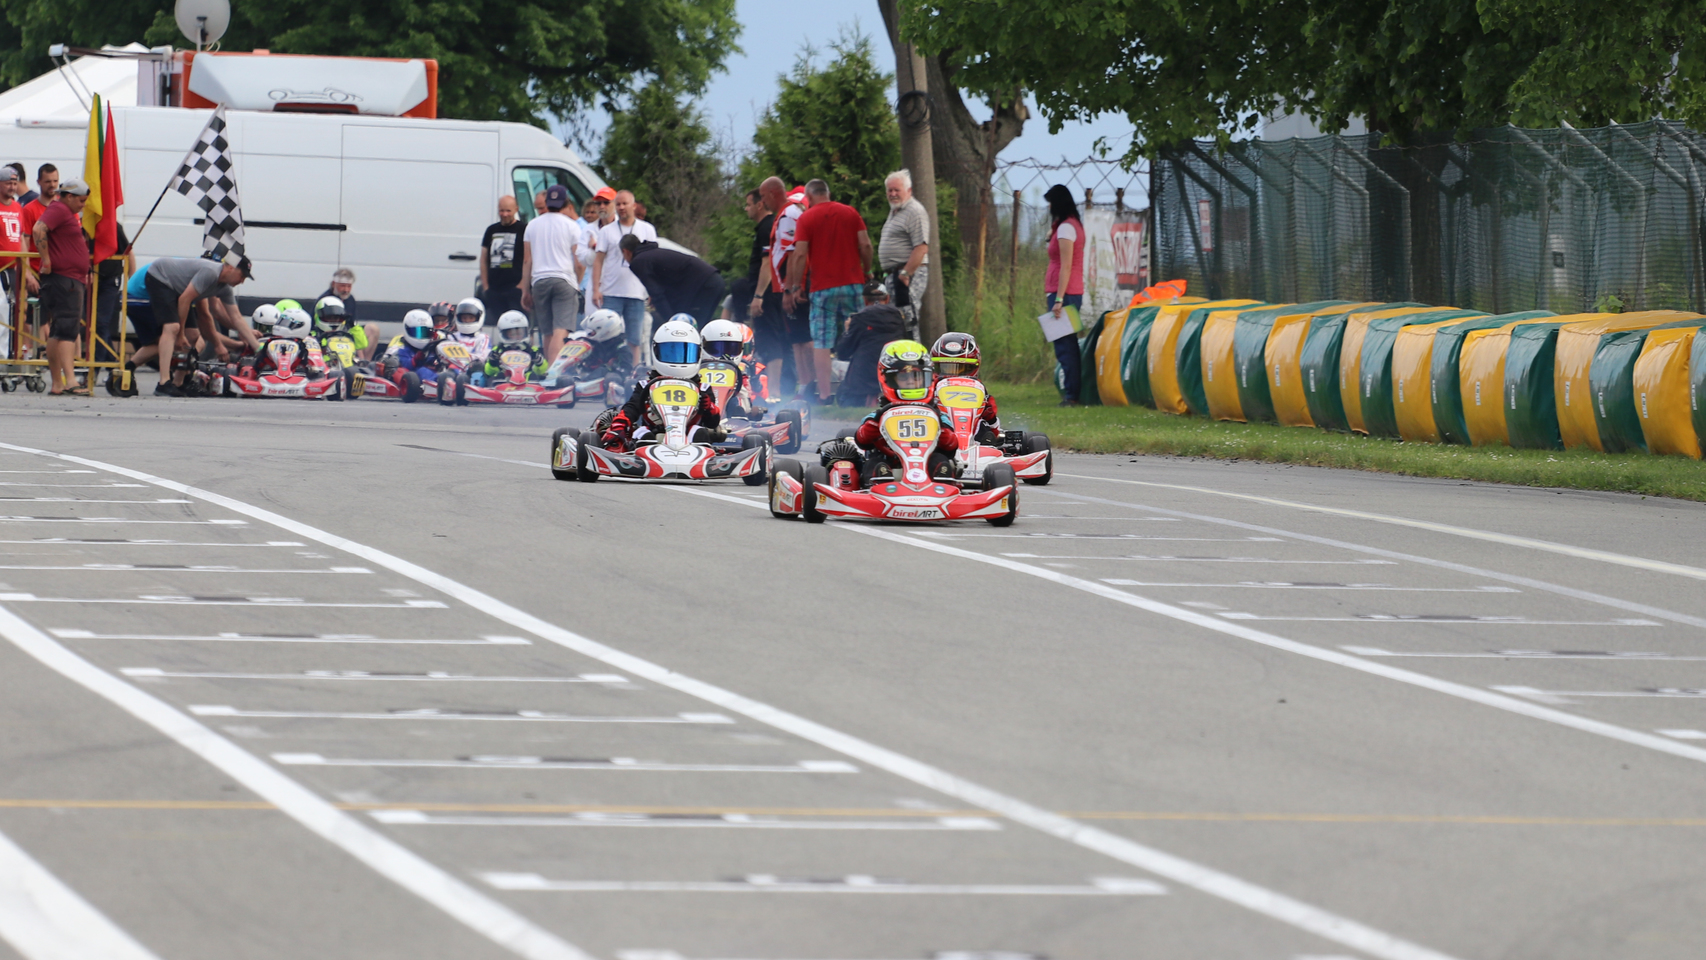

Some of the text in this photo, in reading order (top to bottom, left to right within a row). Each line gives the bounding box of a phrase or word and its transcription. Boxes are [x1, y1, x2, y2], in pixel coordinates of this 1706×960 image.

[2, 218, 20, 237] 10
[447, 346, 466, 357] 111
[705, 372, 727, 385] 12
[662, 389, 687, 403] 18
[945, 391, 978, 403] 72
[898, 418, 927, 438] 55
[892, 509, 938, 518] birelART
